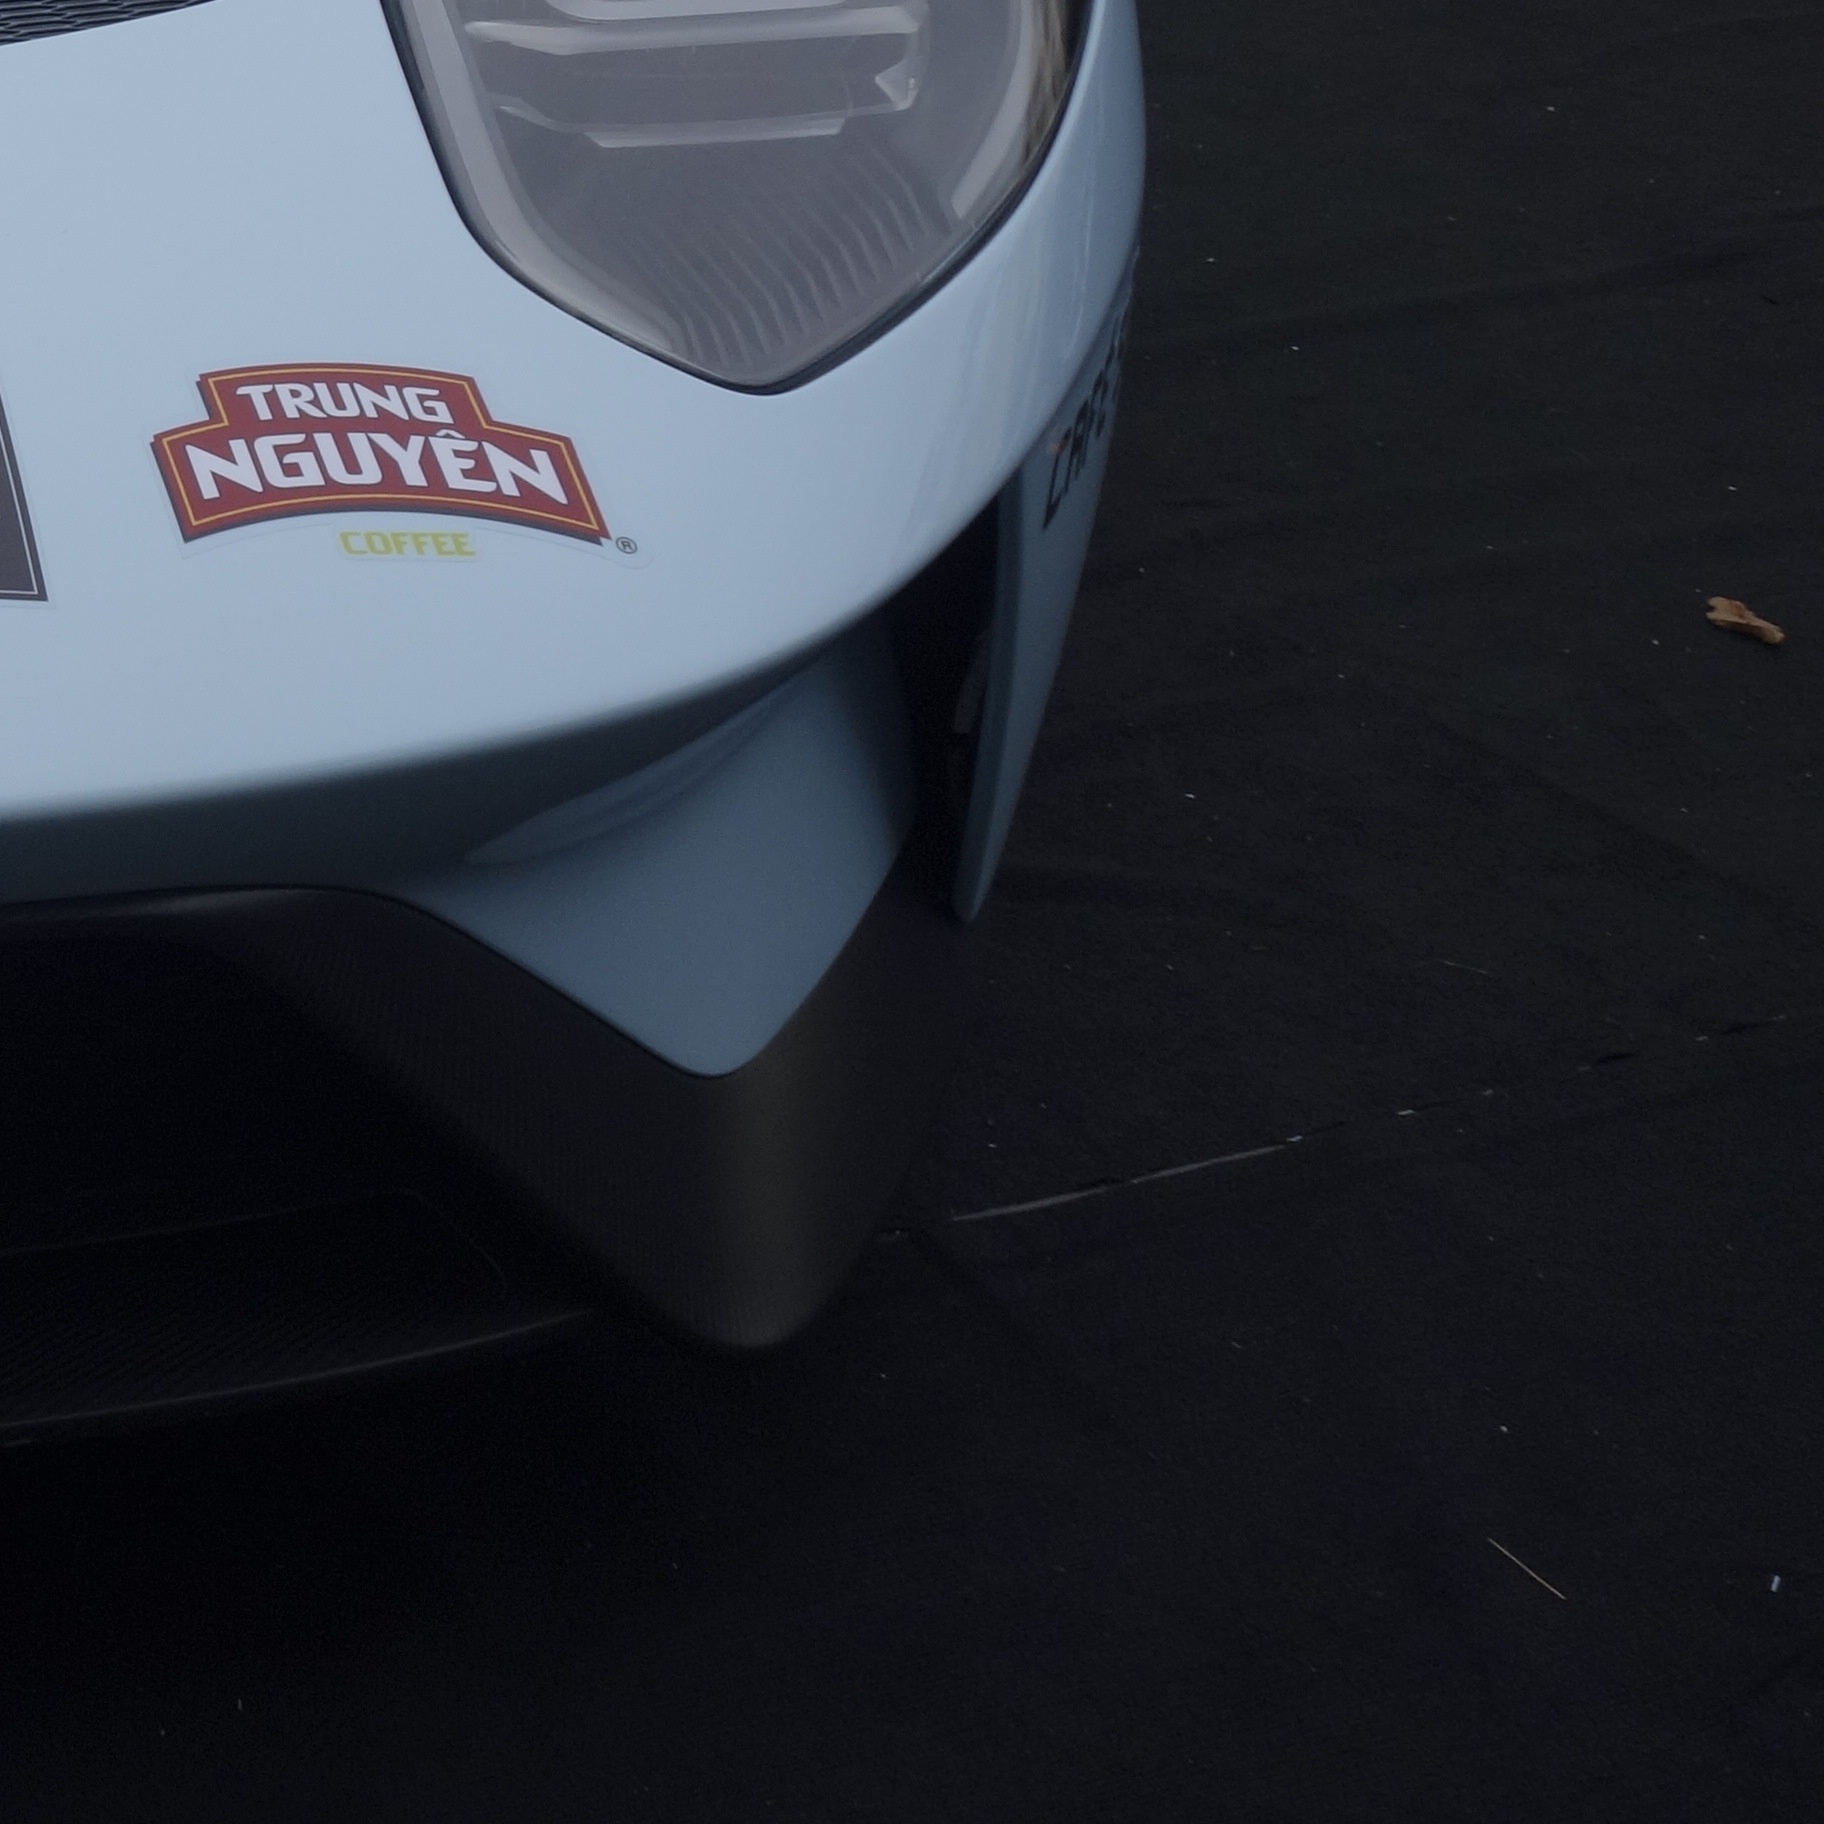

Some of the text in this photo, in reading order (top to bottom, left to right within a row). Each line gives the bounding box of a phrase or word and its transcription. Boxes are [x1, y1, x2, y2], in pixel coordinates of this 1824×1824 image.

[235, 380, 455, 425] TRUNG
[185, 428, 570, 506] NGUYÊN
[339, 530, 477, 558] COFFEE
